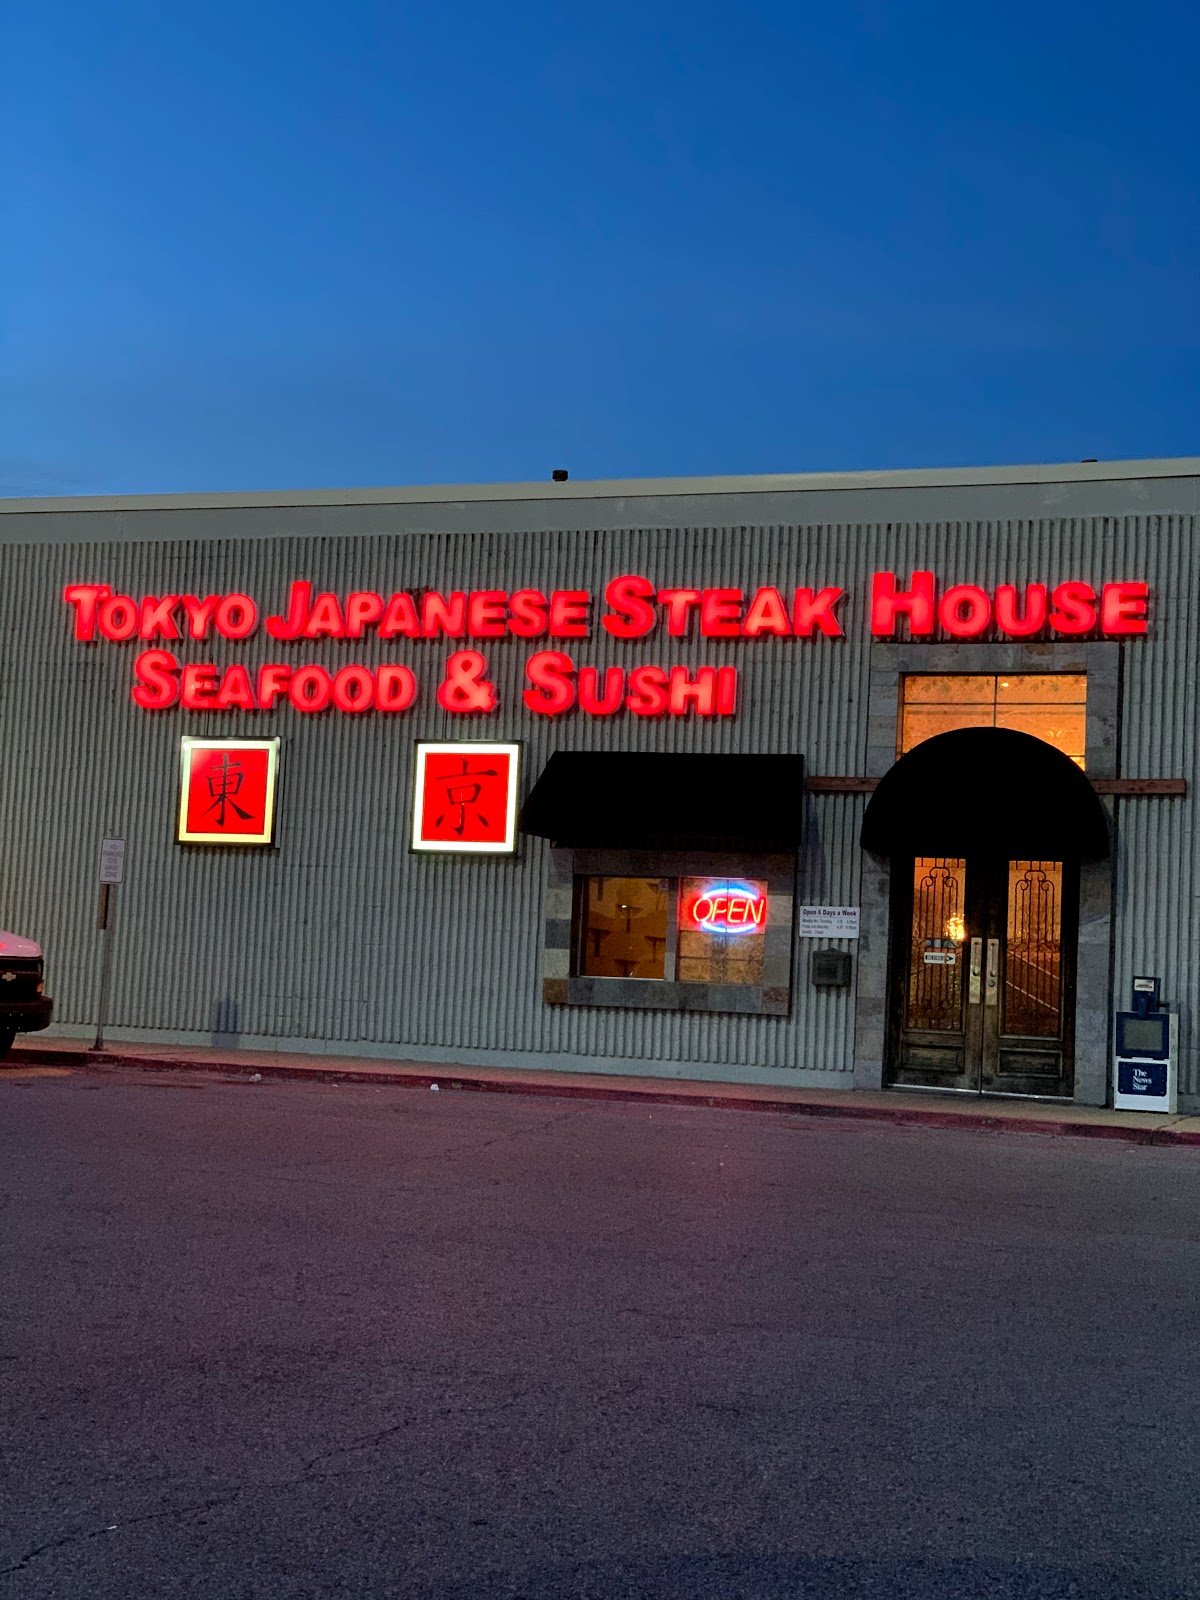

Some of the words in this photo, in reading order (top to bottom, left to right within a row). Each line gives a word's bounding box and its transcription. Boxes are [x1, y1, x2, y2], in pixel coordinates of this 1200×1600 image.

[64, 584, 257, 641] TOKYO
[267, 581, 590, 641] JAPANESE
[602, 575, 845, 638] STEAK
[871, 571, 1149, 637] HOUSE
[132, 649, 416, 713] SEAFOOD
[437, 649, 497, 714] &
[523, 650, 737, 715] SUSHI
[202, 752, 256, 828] 東
[436, 756, 499, 836] 京
[693, 897, 765, 924] OPEN
[823, 909, 836, 917] Days
[1133, 1076, 1152, 1084] News
